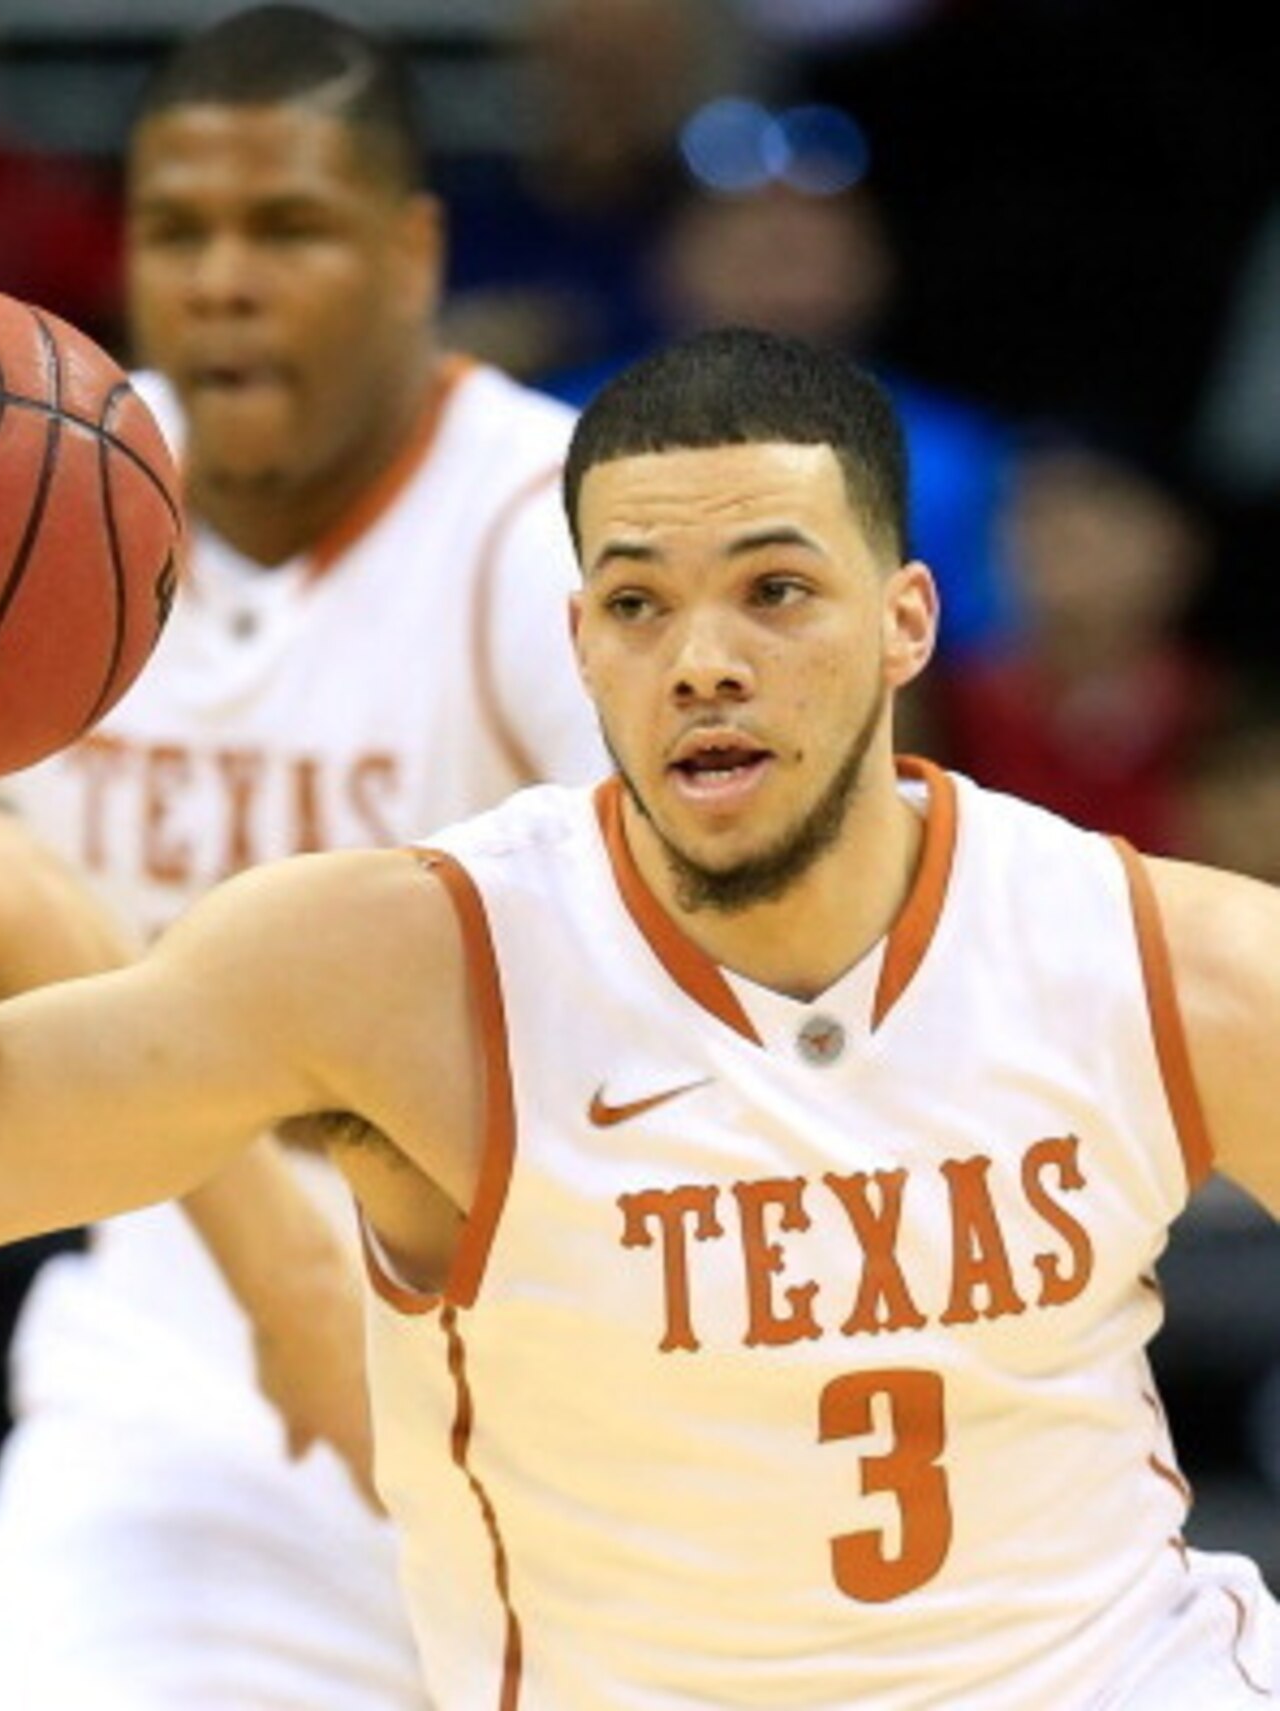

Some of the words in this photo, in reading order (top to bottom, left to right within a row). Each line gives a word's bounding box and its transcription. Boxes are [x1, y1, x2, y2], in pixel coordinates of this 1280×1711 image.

[66, 732, 404, 887] TEXAS
[617, 1133, 1095, 1354] TEXAS
[818, 1368, 954, 1605] 3
